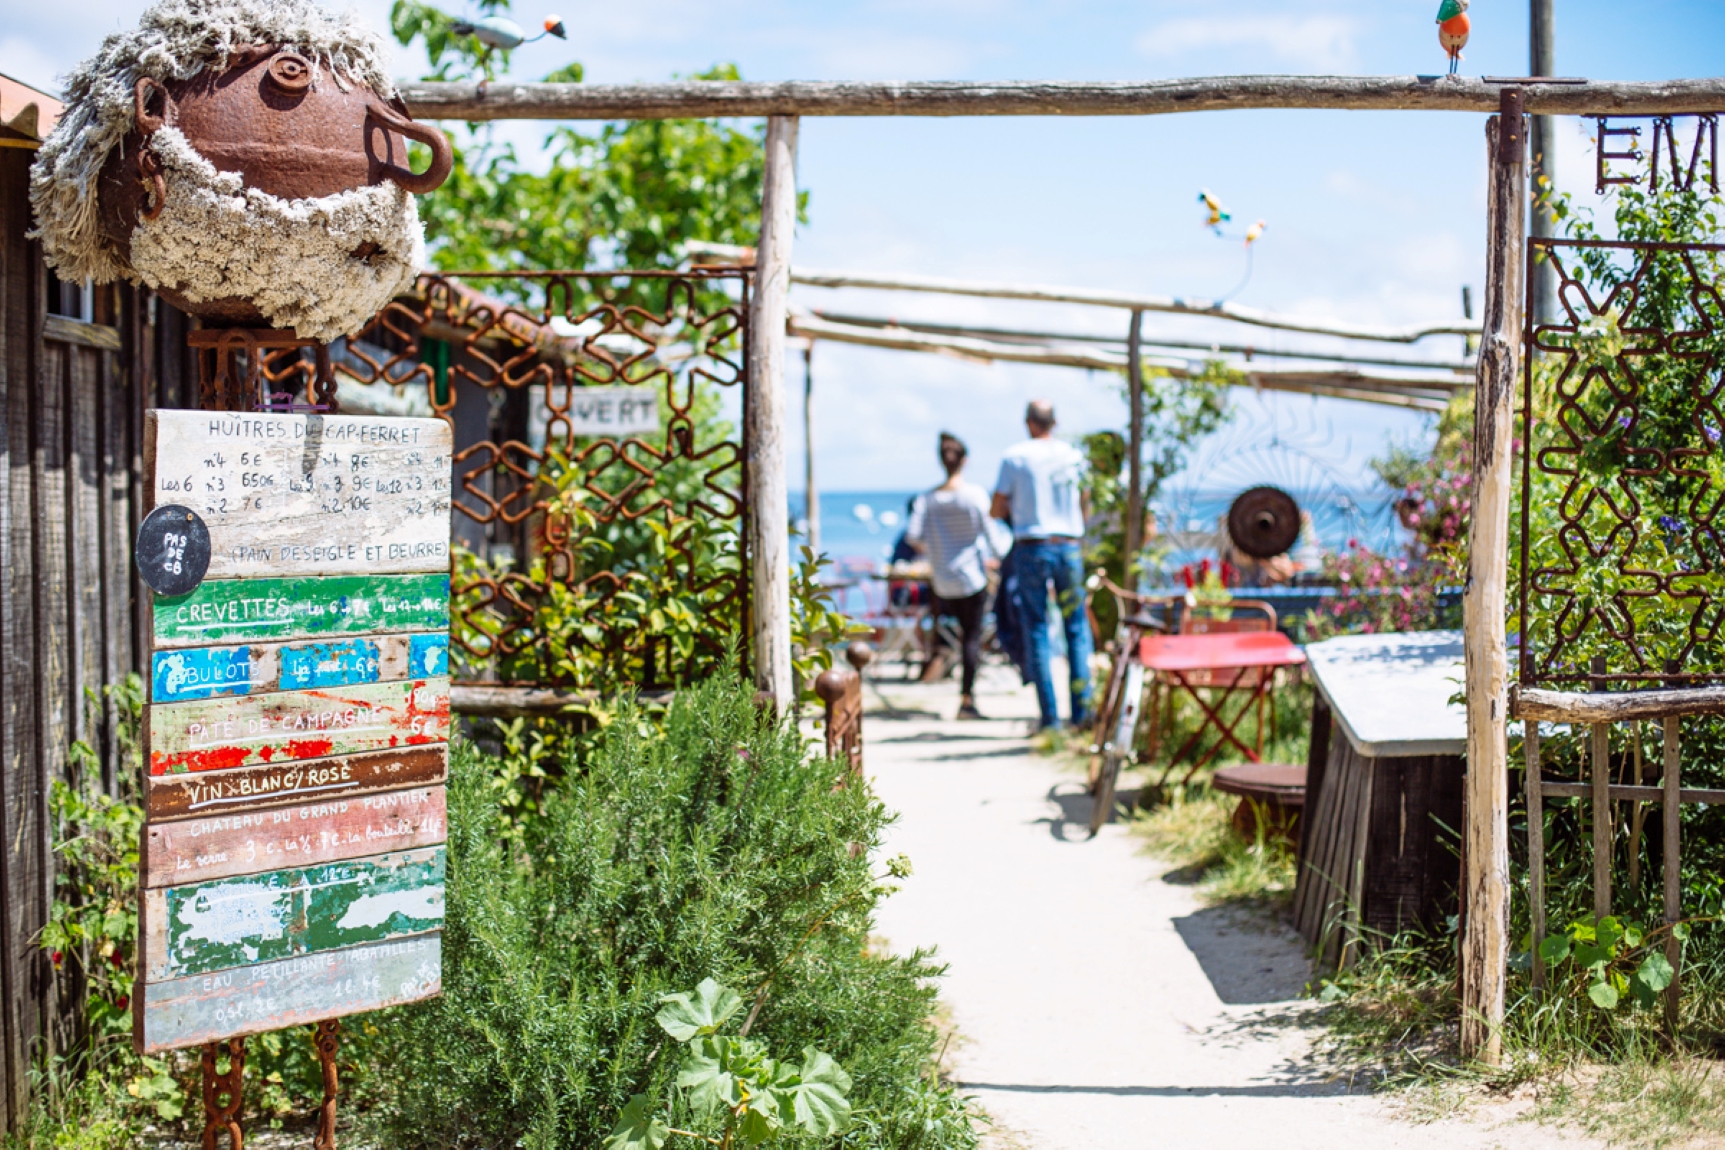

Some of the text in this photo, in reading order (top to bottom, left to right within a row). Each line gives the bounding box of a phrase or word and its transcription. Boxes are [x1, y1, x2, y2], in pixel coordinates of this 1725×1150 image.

[208, 415, 287, 438] HUÎTRES
[294, 422, 316, 438] DU
[164, 532, 187, 548] PAS
[365, 545, 383, 561] ET
[177, 597, 290, 623] CREVETTES
[187, 661, 260, 684] BULOTS
[249, 718, 270, 734] DE
[282, 706, 382, 731] CAMPAGNE
[190, 782, 222, 804] VIN
[273, 811, 291, 825] DU
[300, 802, 349, 819] GRAND
[364, 790, 429, 810] PLANTIER
[203, 973, 232, 992] EAU
